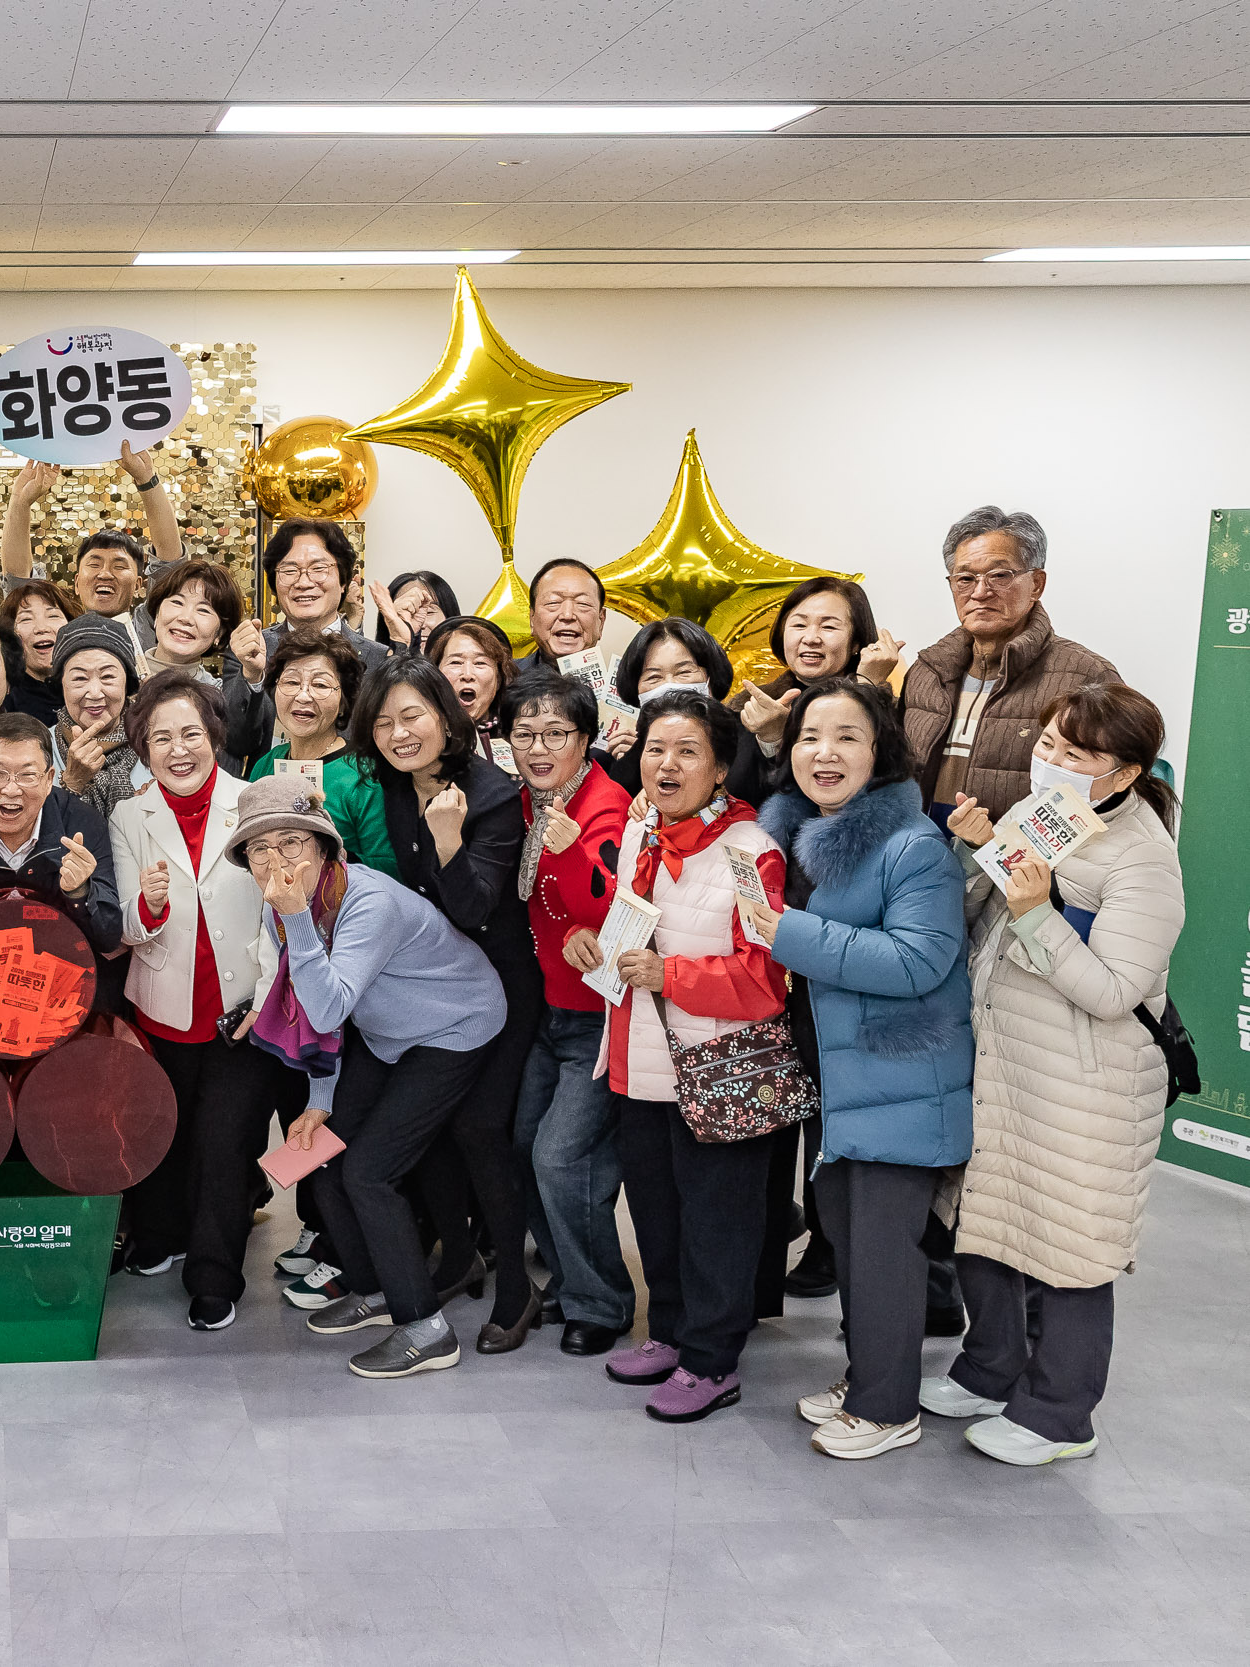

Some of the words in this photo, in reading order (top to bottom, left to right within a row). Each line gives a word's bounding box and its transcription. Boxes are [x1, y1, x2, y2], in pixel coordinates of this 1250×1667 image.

[1226, 608, 1250, 634] 광
[1027, 814, 1064, 852] 겨울나기
[1034, 806, 1073, 847] 따뜻한
[7, 972, 46, 992] 따뜻한
[40, 1225, 72, 1241] 열매
